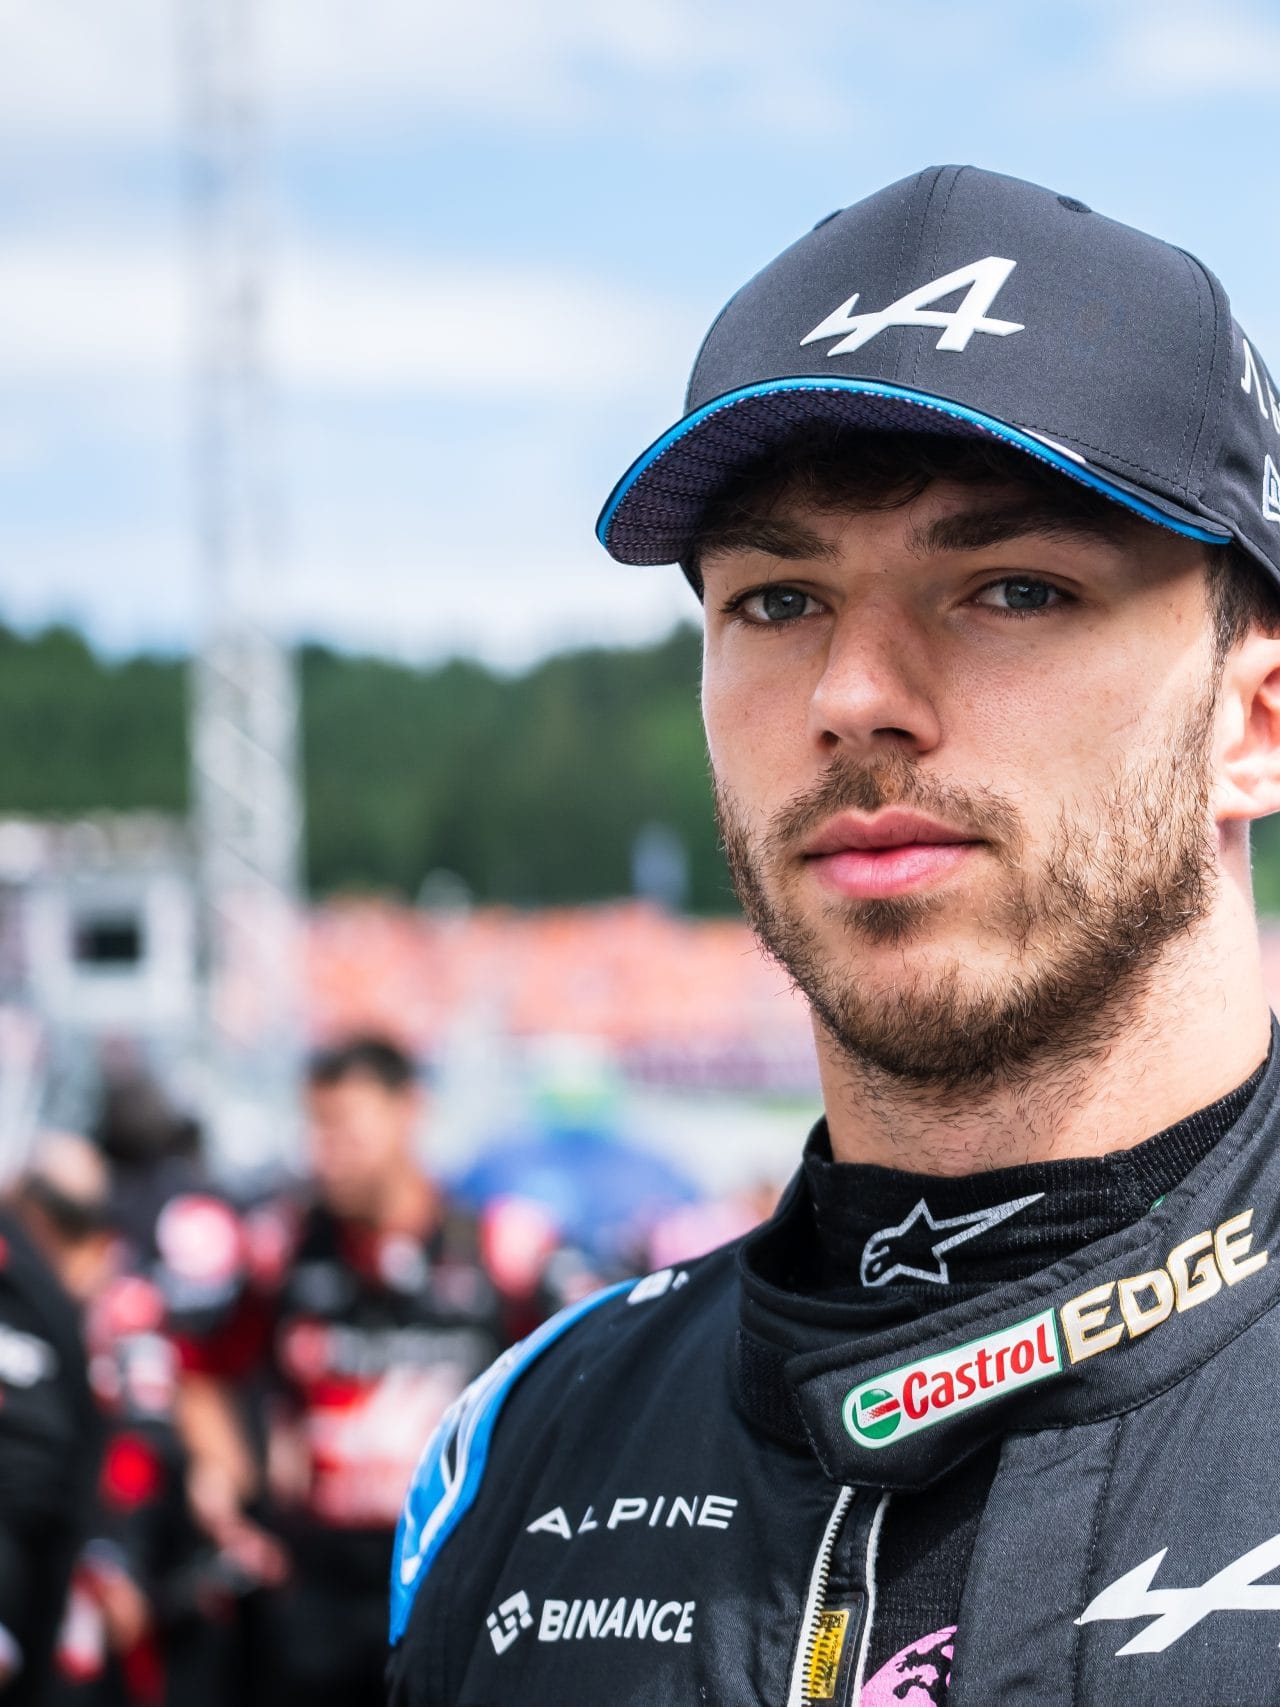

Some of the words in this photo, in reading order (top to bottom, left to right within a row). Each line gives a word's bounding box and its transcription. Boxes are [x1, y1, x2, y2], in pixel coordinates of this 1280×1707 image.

[901, 1323, 1055, 1420] Castrol
[1059, 1207, 1269, 1365] EDGE
[526, 1494, 739, 1541] ALPINE
[537, 1596, 696, 1643] BINANCE
